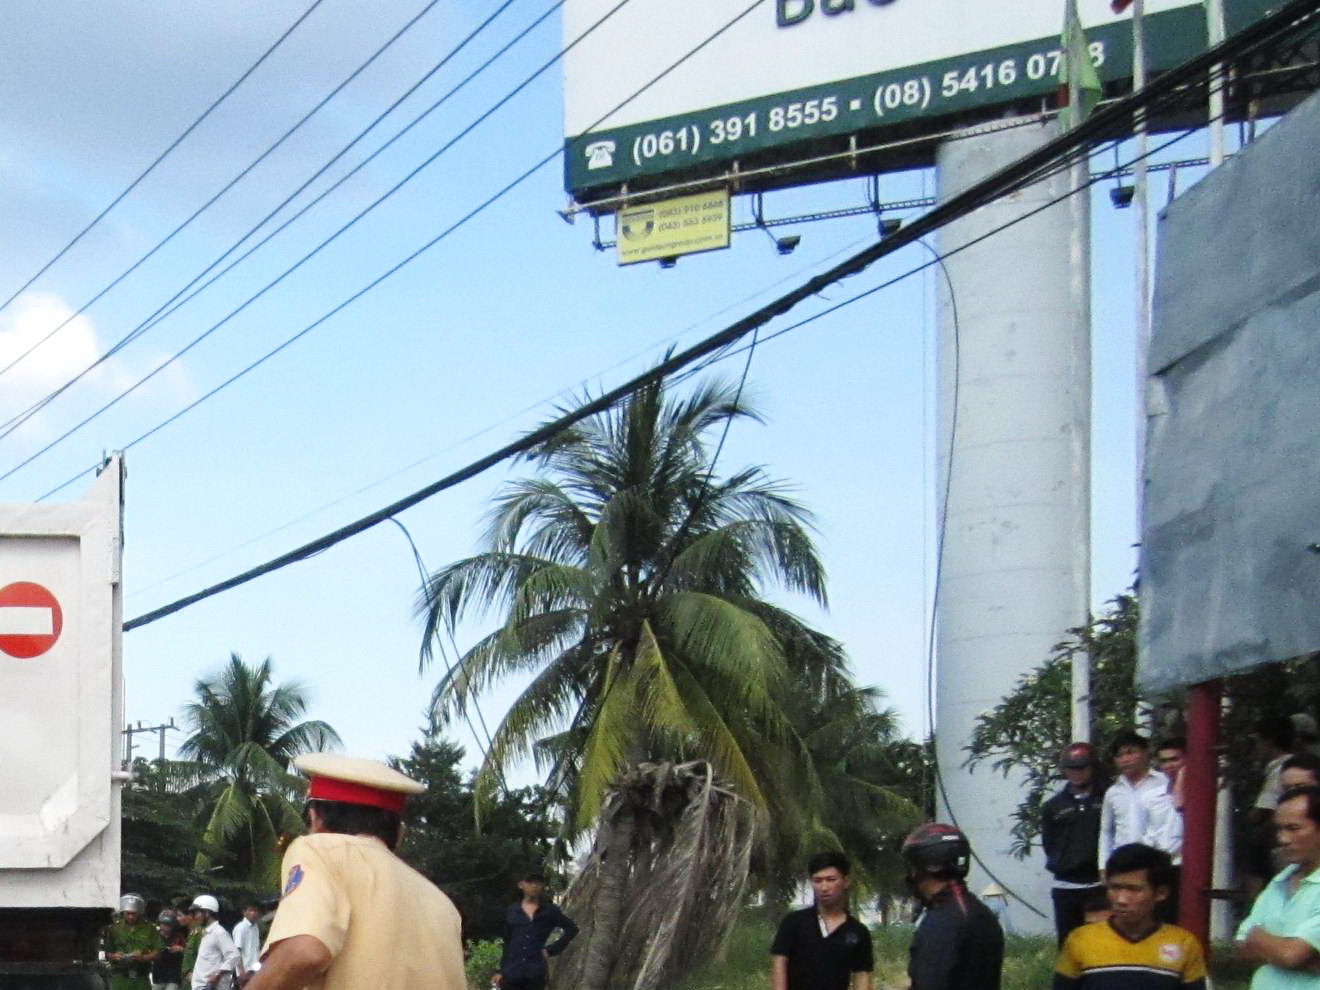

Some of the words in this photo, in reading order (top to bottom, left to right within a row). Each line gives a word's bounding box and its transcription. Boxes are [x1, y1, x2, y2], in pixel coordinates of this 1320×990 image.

[633, 125, 700, 167] (061)
[709, 113, 757, 144] 391
[769, 97, 838, 132] 8555
[874, 78, 930, 116] (08)
[941, 60, 1017, 97] 5416
[1026, 41, 1105, 79] 078
